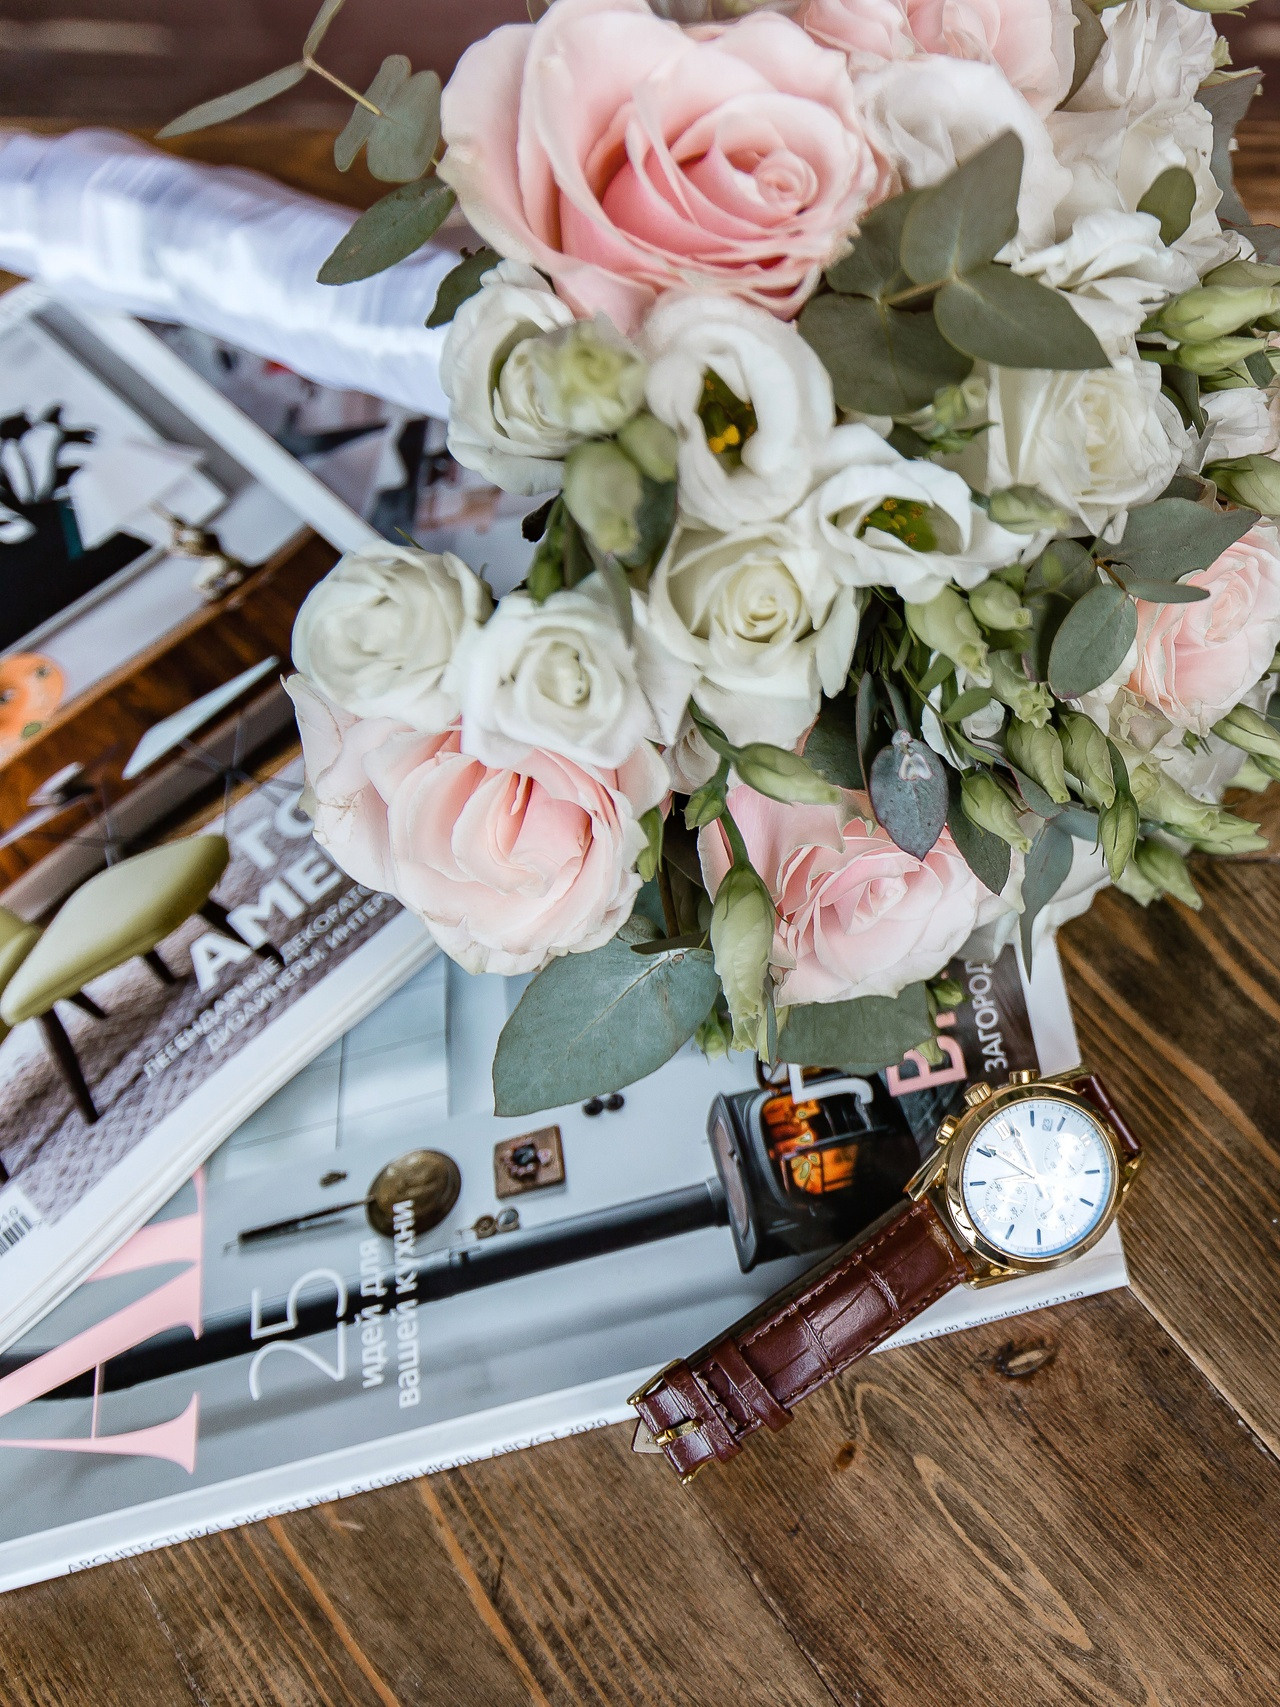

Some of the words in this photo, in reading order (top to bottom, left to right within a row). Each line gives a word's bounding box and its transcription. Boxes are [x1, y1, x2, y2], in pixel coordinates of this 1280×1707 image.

[324, 890, 396, 950] ИНТЕР
[359, 1237, 388, 1298] для
[391, 1198, 420, 1295] кухни
[248, 1267, 349, 1401] 25
[353, 1302, 388, 1389] идей
[388, 1298, 421, 1410] вашей
